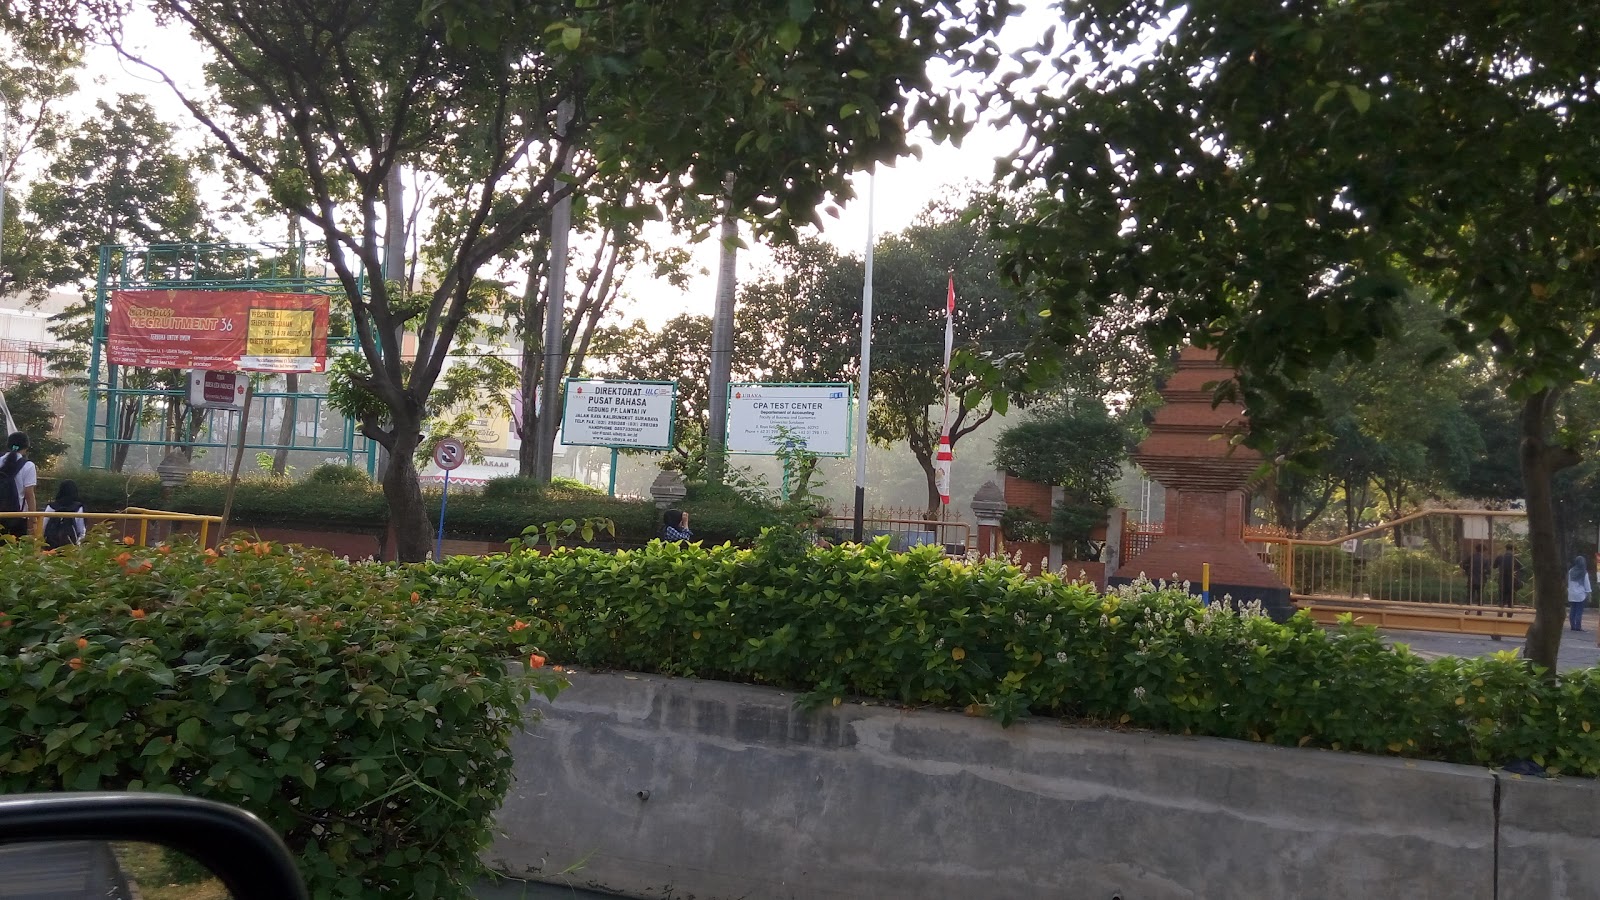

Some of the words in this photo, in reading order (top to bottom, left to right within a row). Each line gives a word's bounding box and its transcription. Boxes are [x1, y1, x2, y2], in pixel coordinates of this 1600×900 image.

[130, 316, 218, 331] RECRUITMENT
[219, 318, 233, 332] 36
[595, 386, 642, 396] DIREKTORAT
[588, 396, 613, 405] PUSAT
[615, 398, 647, 407] BAHASA
[791, 402, 823, 410] CENTER
